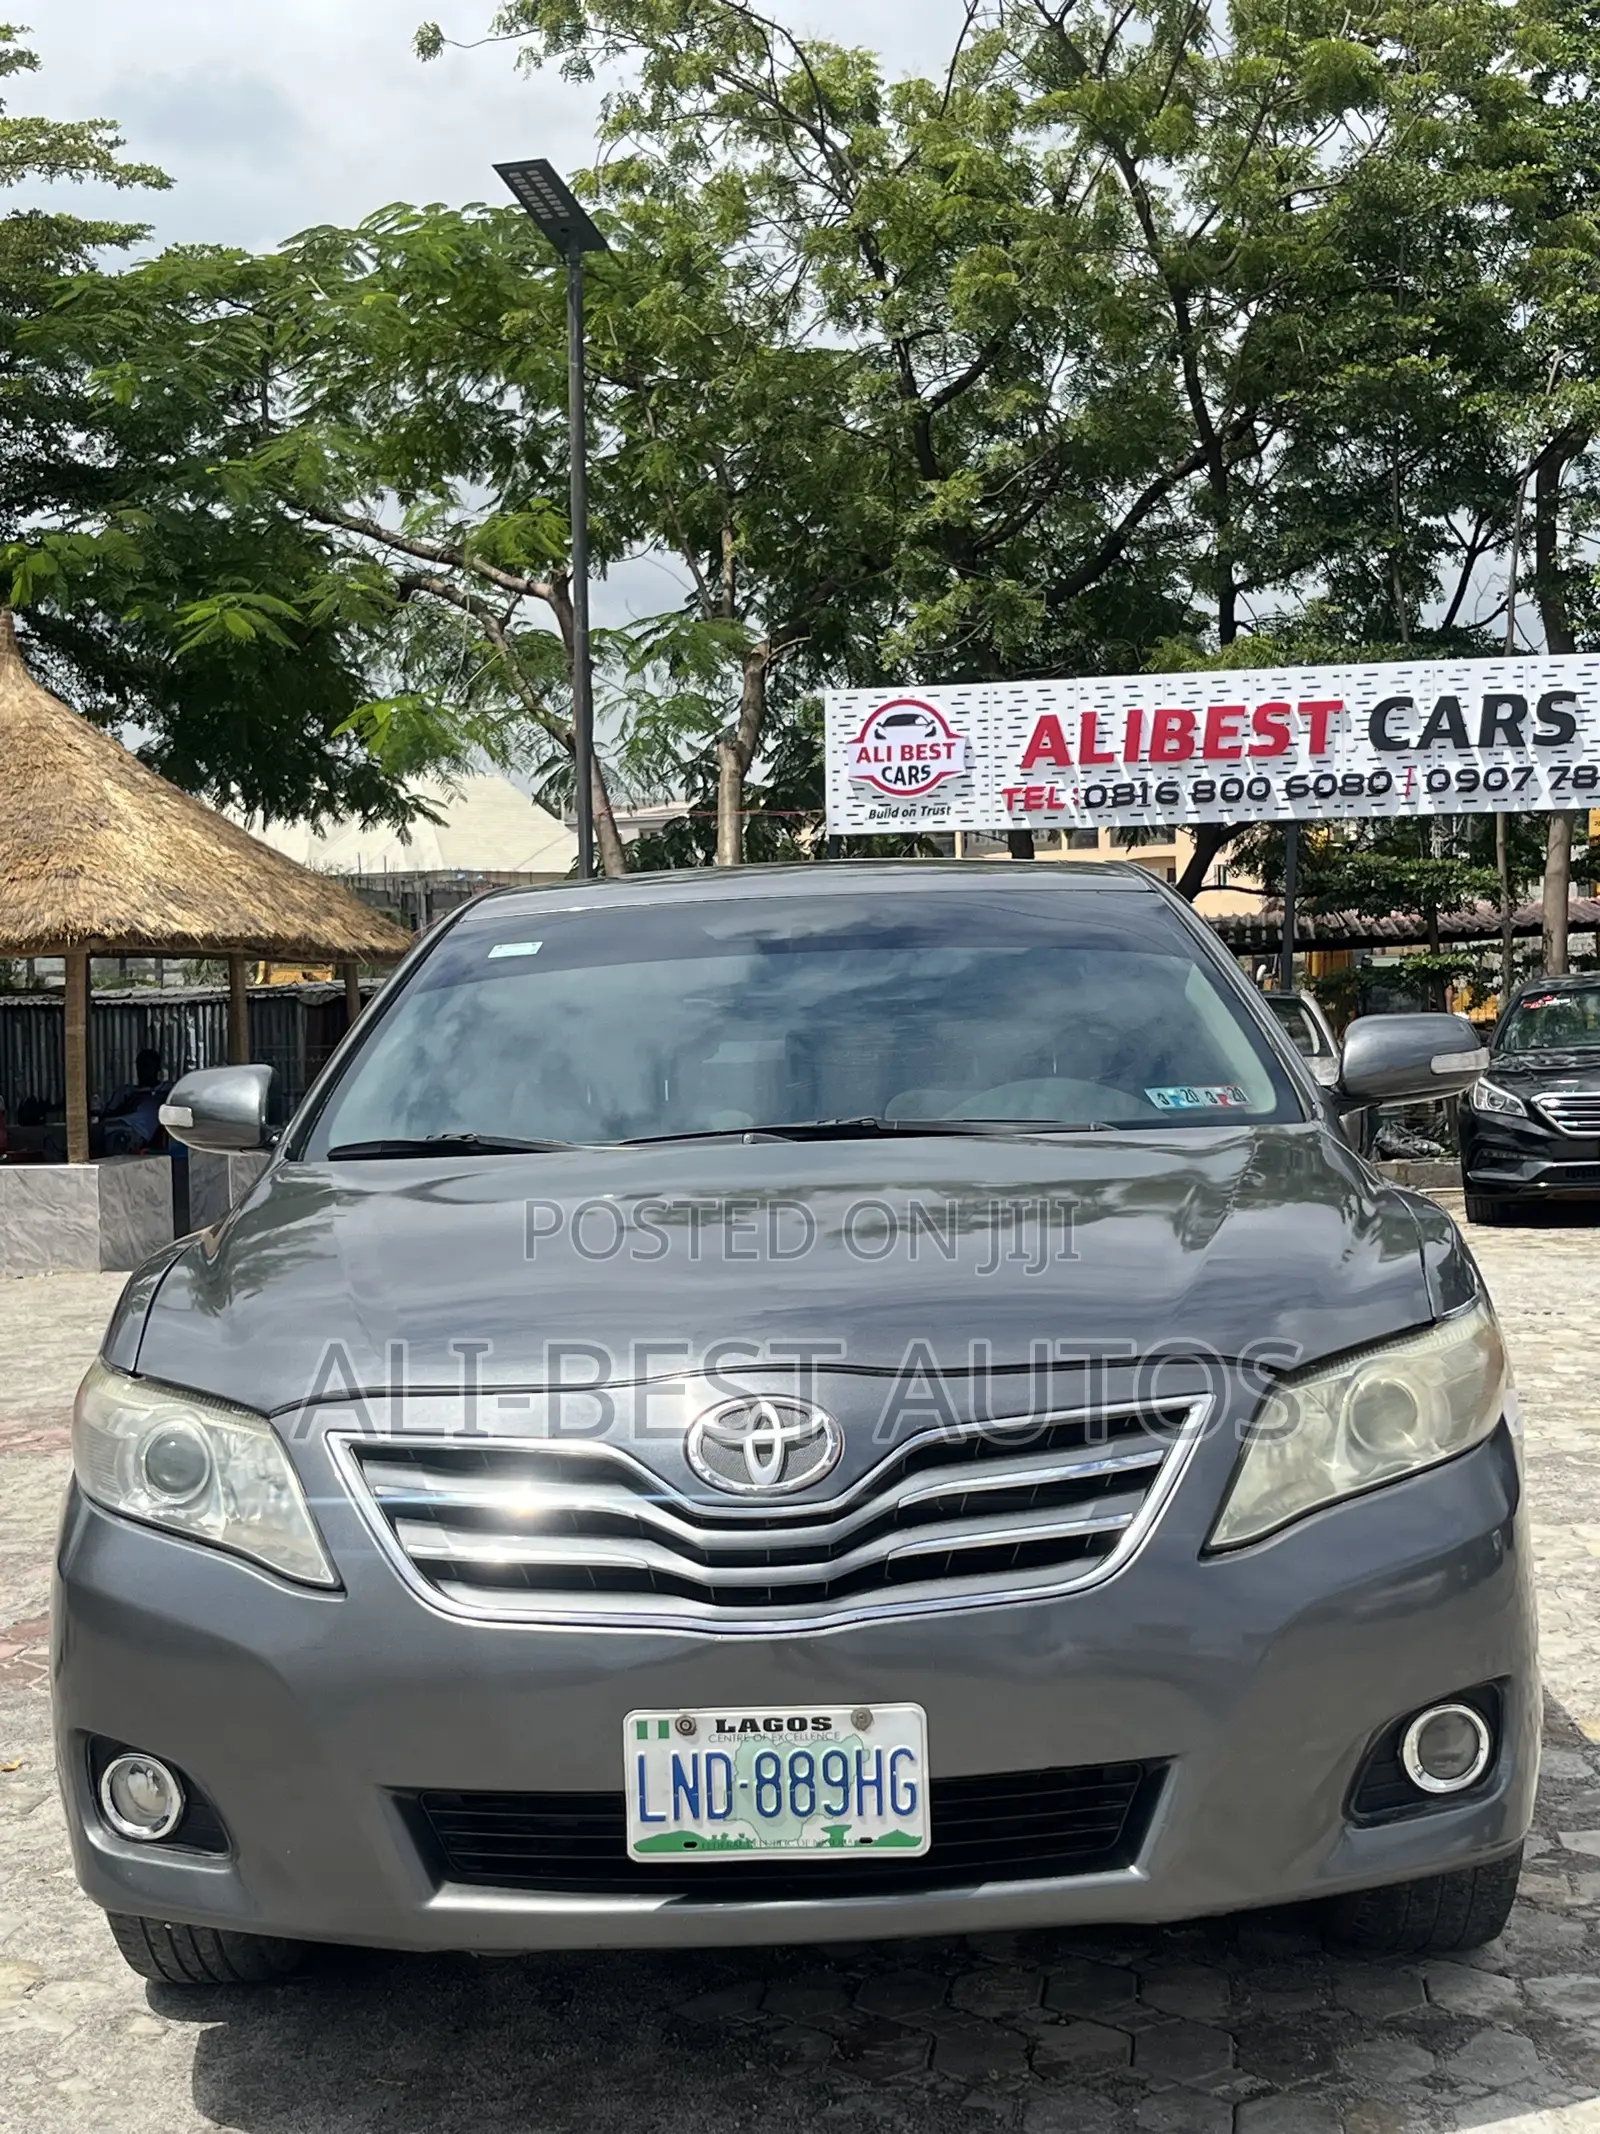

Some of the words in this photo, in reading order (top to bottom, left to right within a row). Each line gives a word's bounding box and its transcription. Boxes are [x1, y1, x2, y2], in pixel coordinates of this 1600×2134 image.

[1020, 700, 1344, 770] ALIBEST
[1367, 690, 1577, 752] CARS
[856, 745, 893, 764] ALI
[900, 742, 957, 762] BEST
[881, 764, 932, 786] CARS
[1191, 776, 1272, 806] 800
[1285, 770, 1393, 799] 6080
[1426, 765, 1535, 794] 0907
[1548, 764, 1599, 790] 78
[868, 805, 900, 820] Build
[902, 807, 917, 818] on
[920, 805, 952, 817] Trust
[715, 1716, 833, 1734] LAGOS
[708, 1733, 750, 1744] CENTRE
[753, 1732, 767, 1742] OF
[771, 1730, 841, 1742] EXCELLENCE
[636, 1746, 918, 1822] LND-889HG
